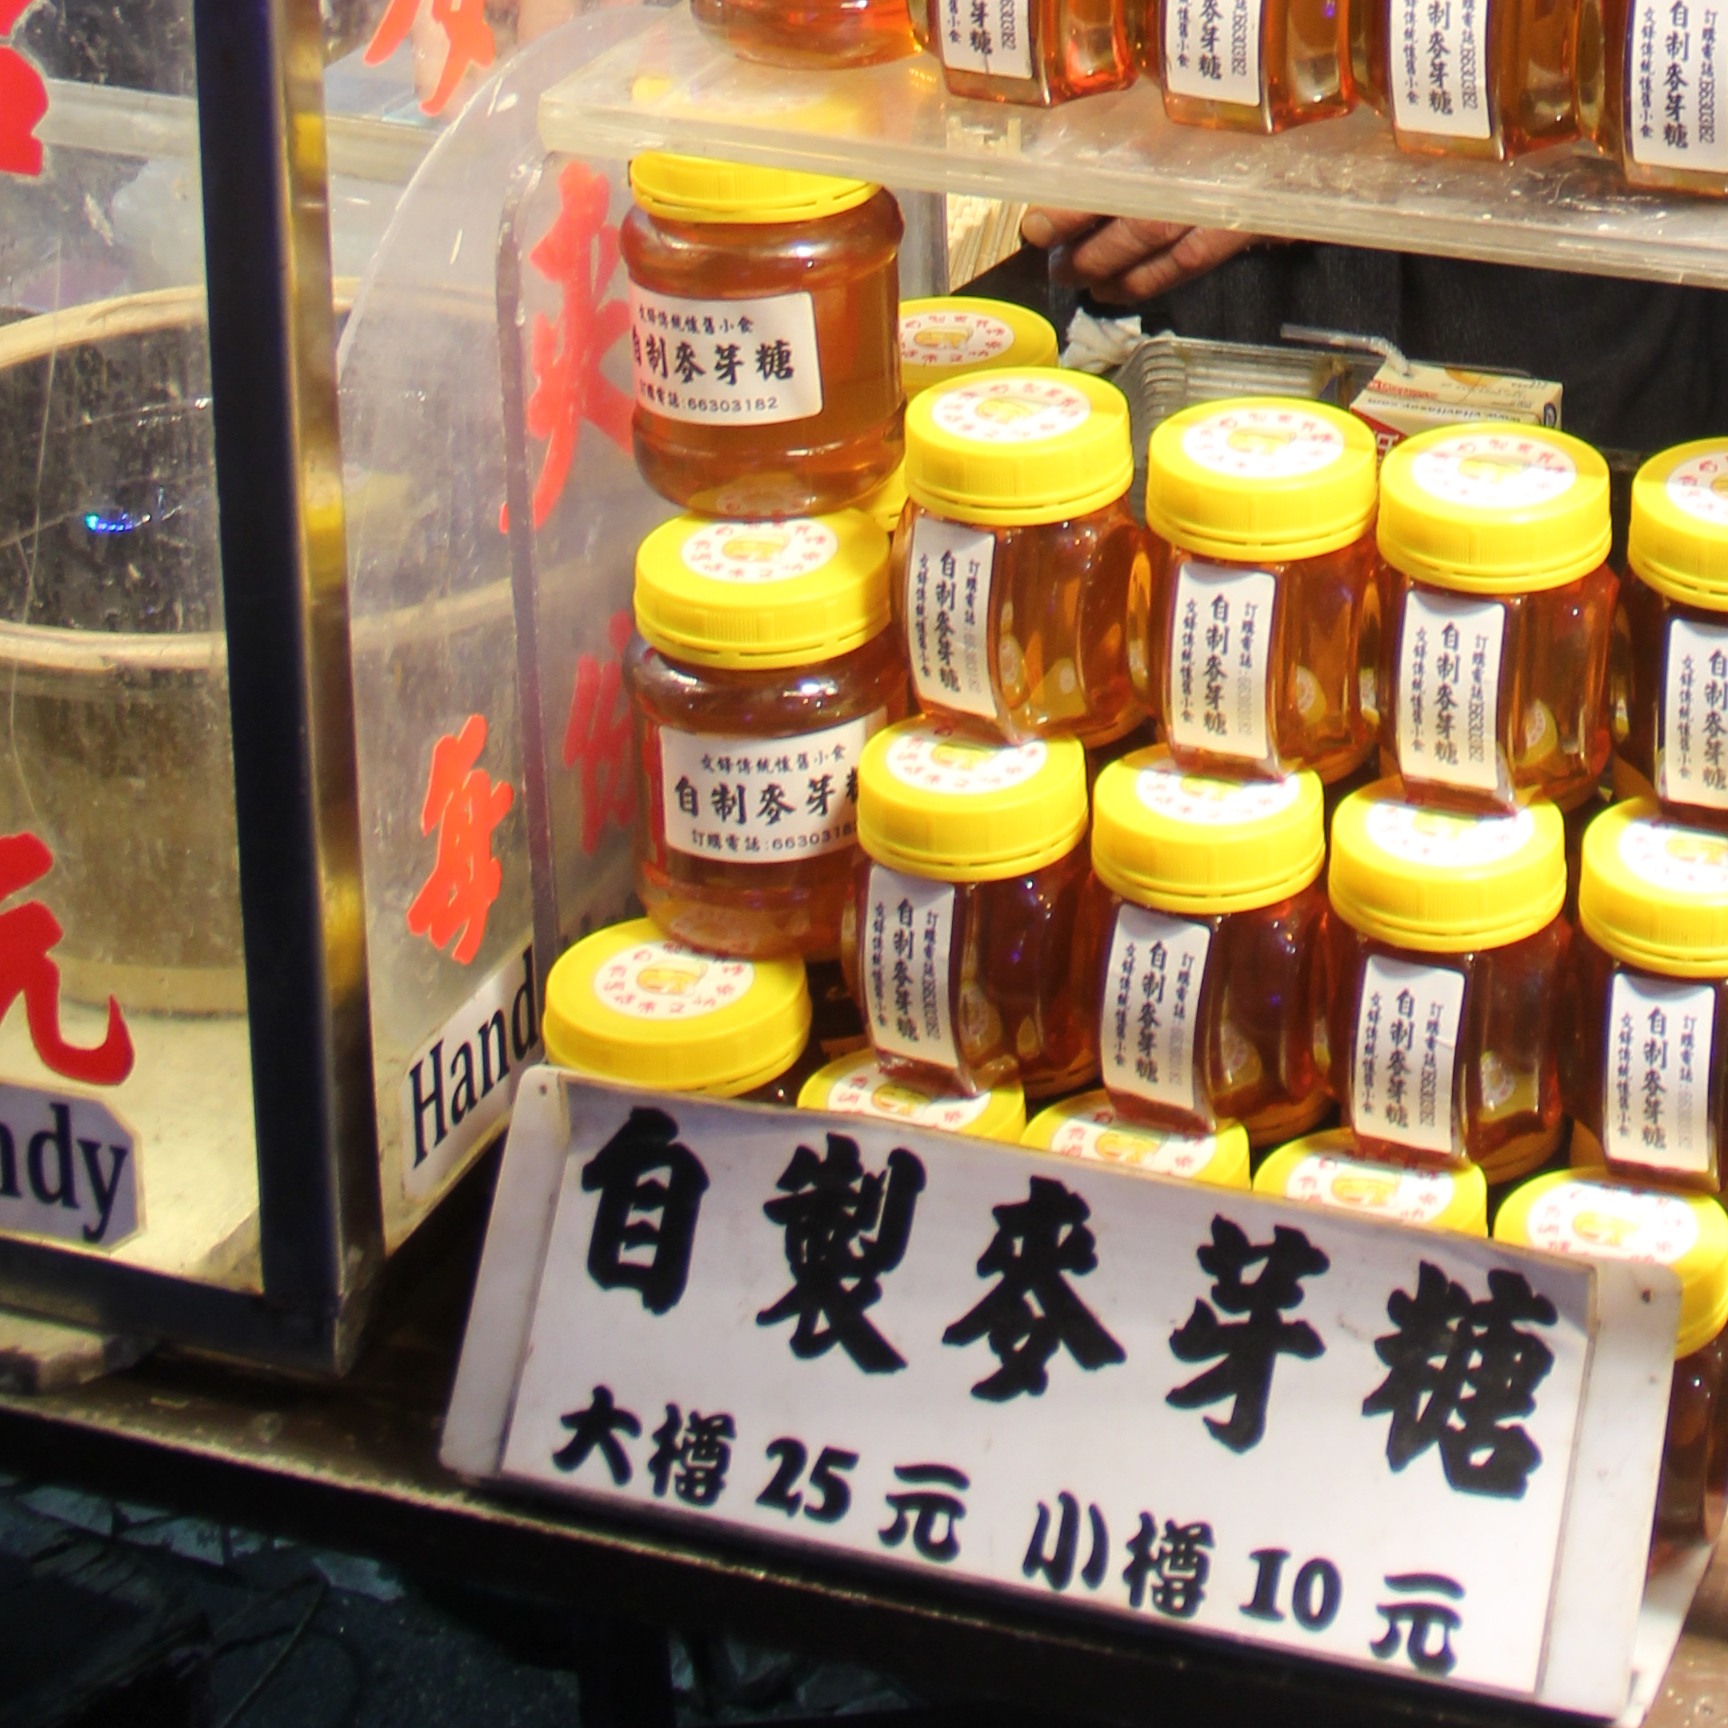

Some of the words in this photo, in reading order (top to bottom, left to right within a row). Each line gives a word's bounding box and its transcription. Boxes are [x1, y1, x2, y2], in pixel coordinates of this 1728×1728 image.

[632, 325, 795, 386] 自制麥芽糖
[1203, 594, 1230, 737] 自制麥芽糖
[1433, 621, 1461, 767] 自制麥芽糖
[691, 821, 858, 853] 訂購電話:6630318
[1641, 1005, 1670, 1151] 自制麥芽糖
[580, 1106, 1559, 1501] 自製麥芽糖
